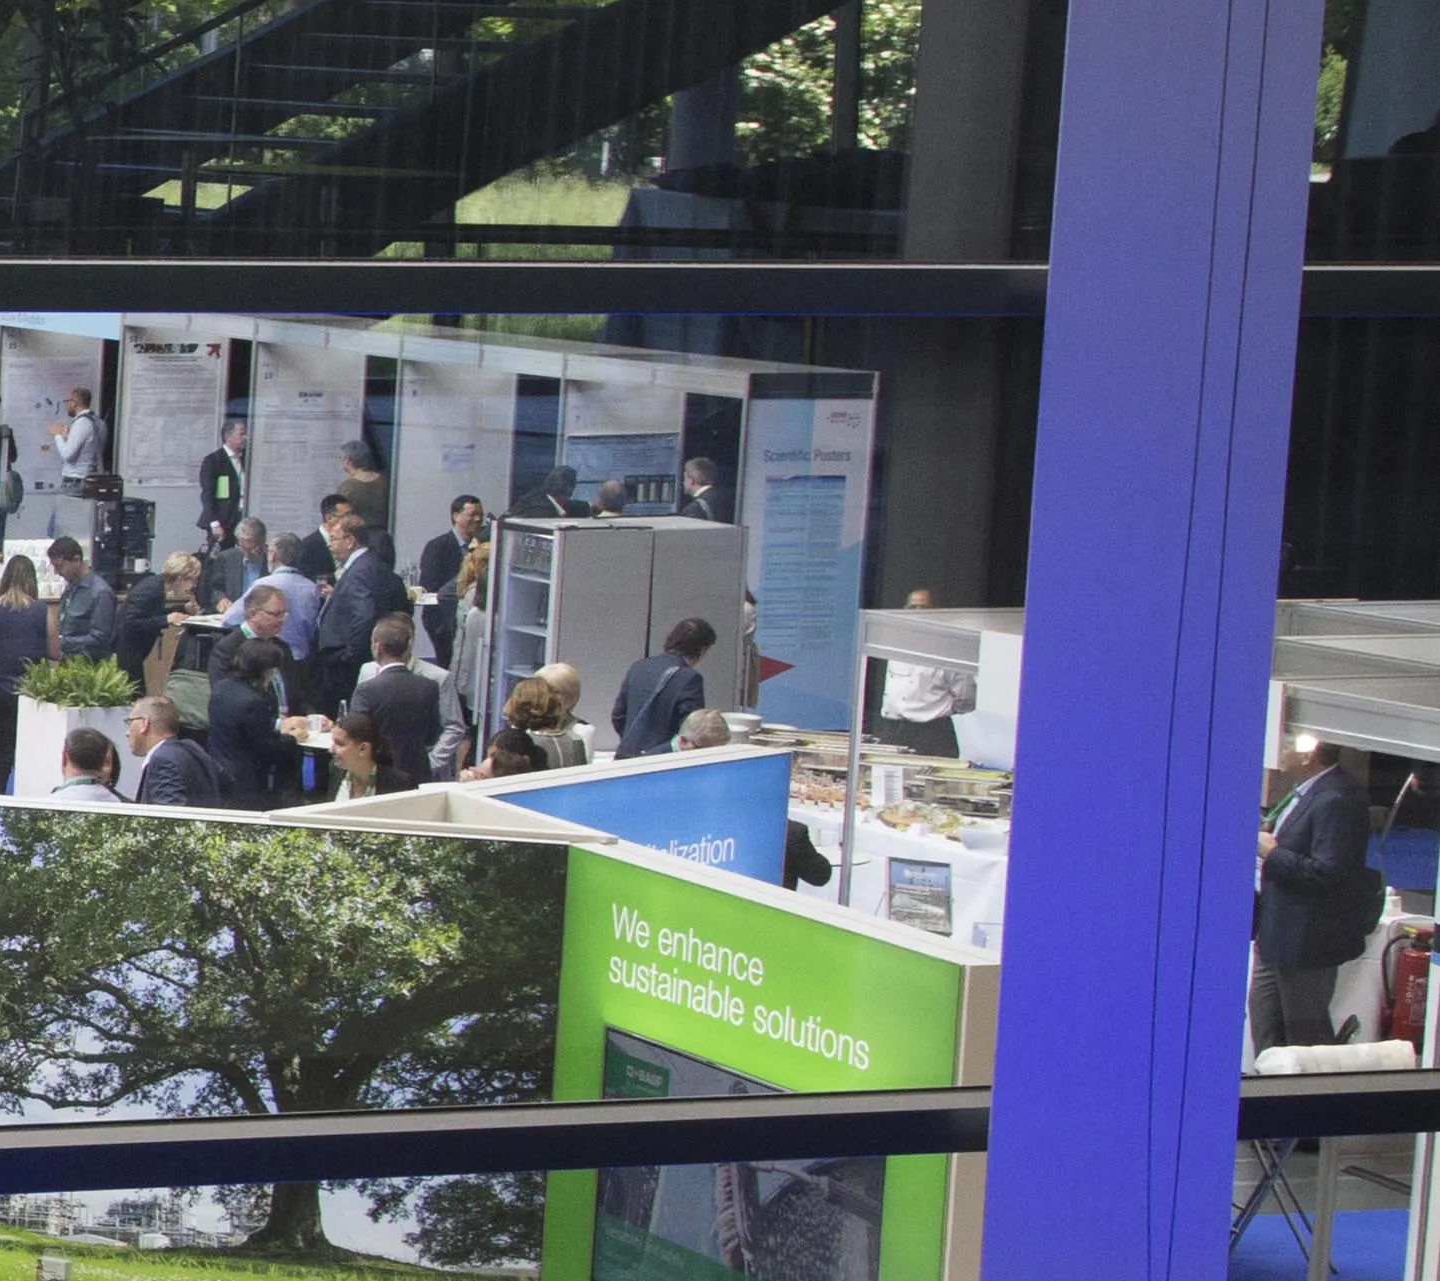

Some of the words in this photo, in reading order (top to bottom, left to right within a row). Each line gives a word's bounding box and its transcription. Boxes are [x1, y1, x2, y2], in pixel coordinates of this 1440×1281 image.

[813, 449, 851, 461] Posters
[612, 903, 650, 946] We
[657, 928, 764, 987] enhance
[608, 956, 745, 1025] sustainable
[752, 1003, 870, 1071] solutions
